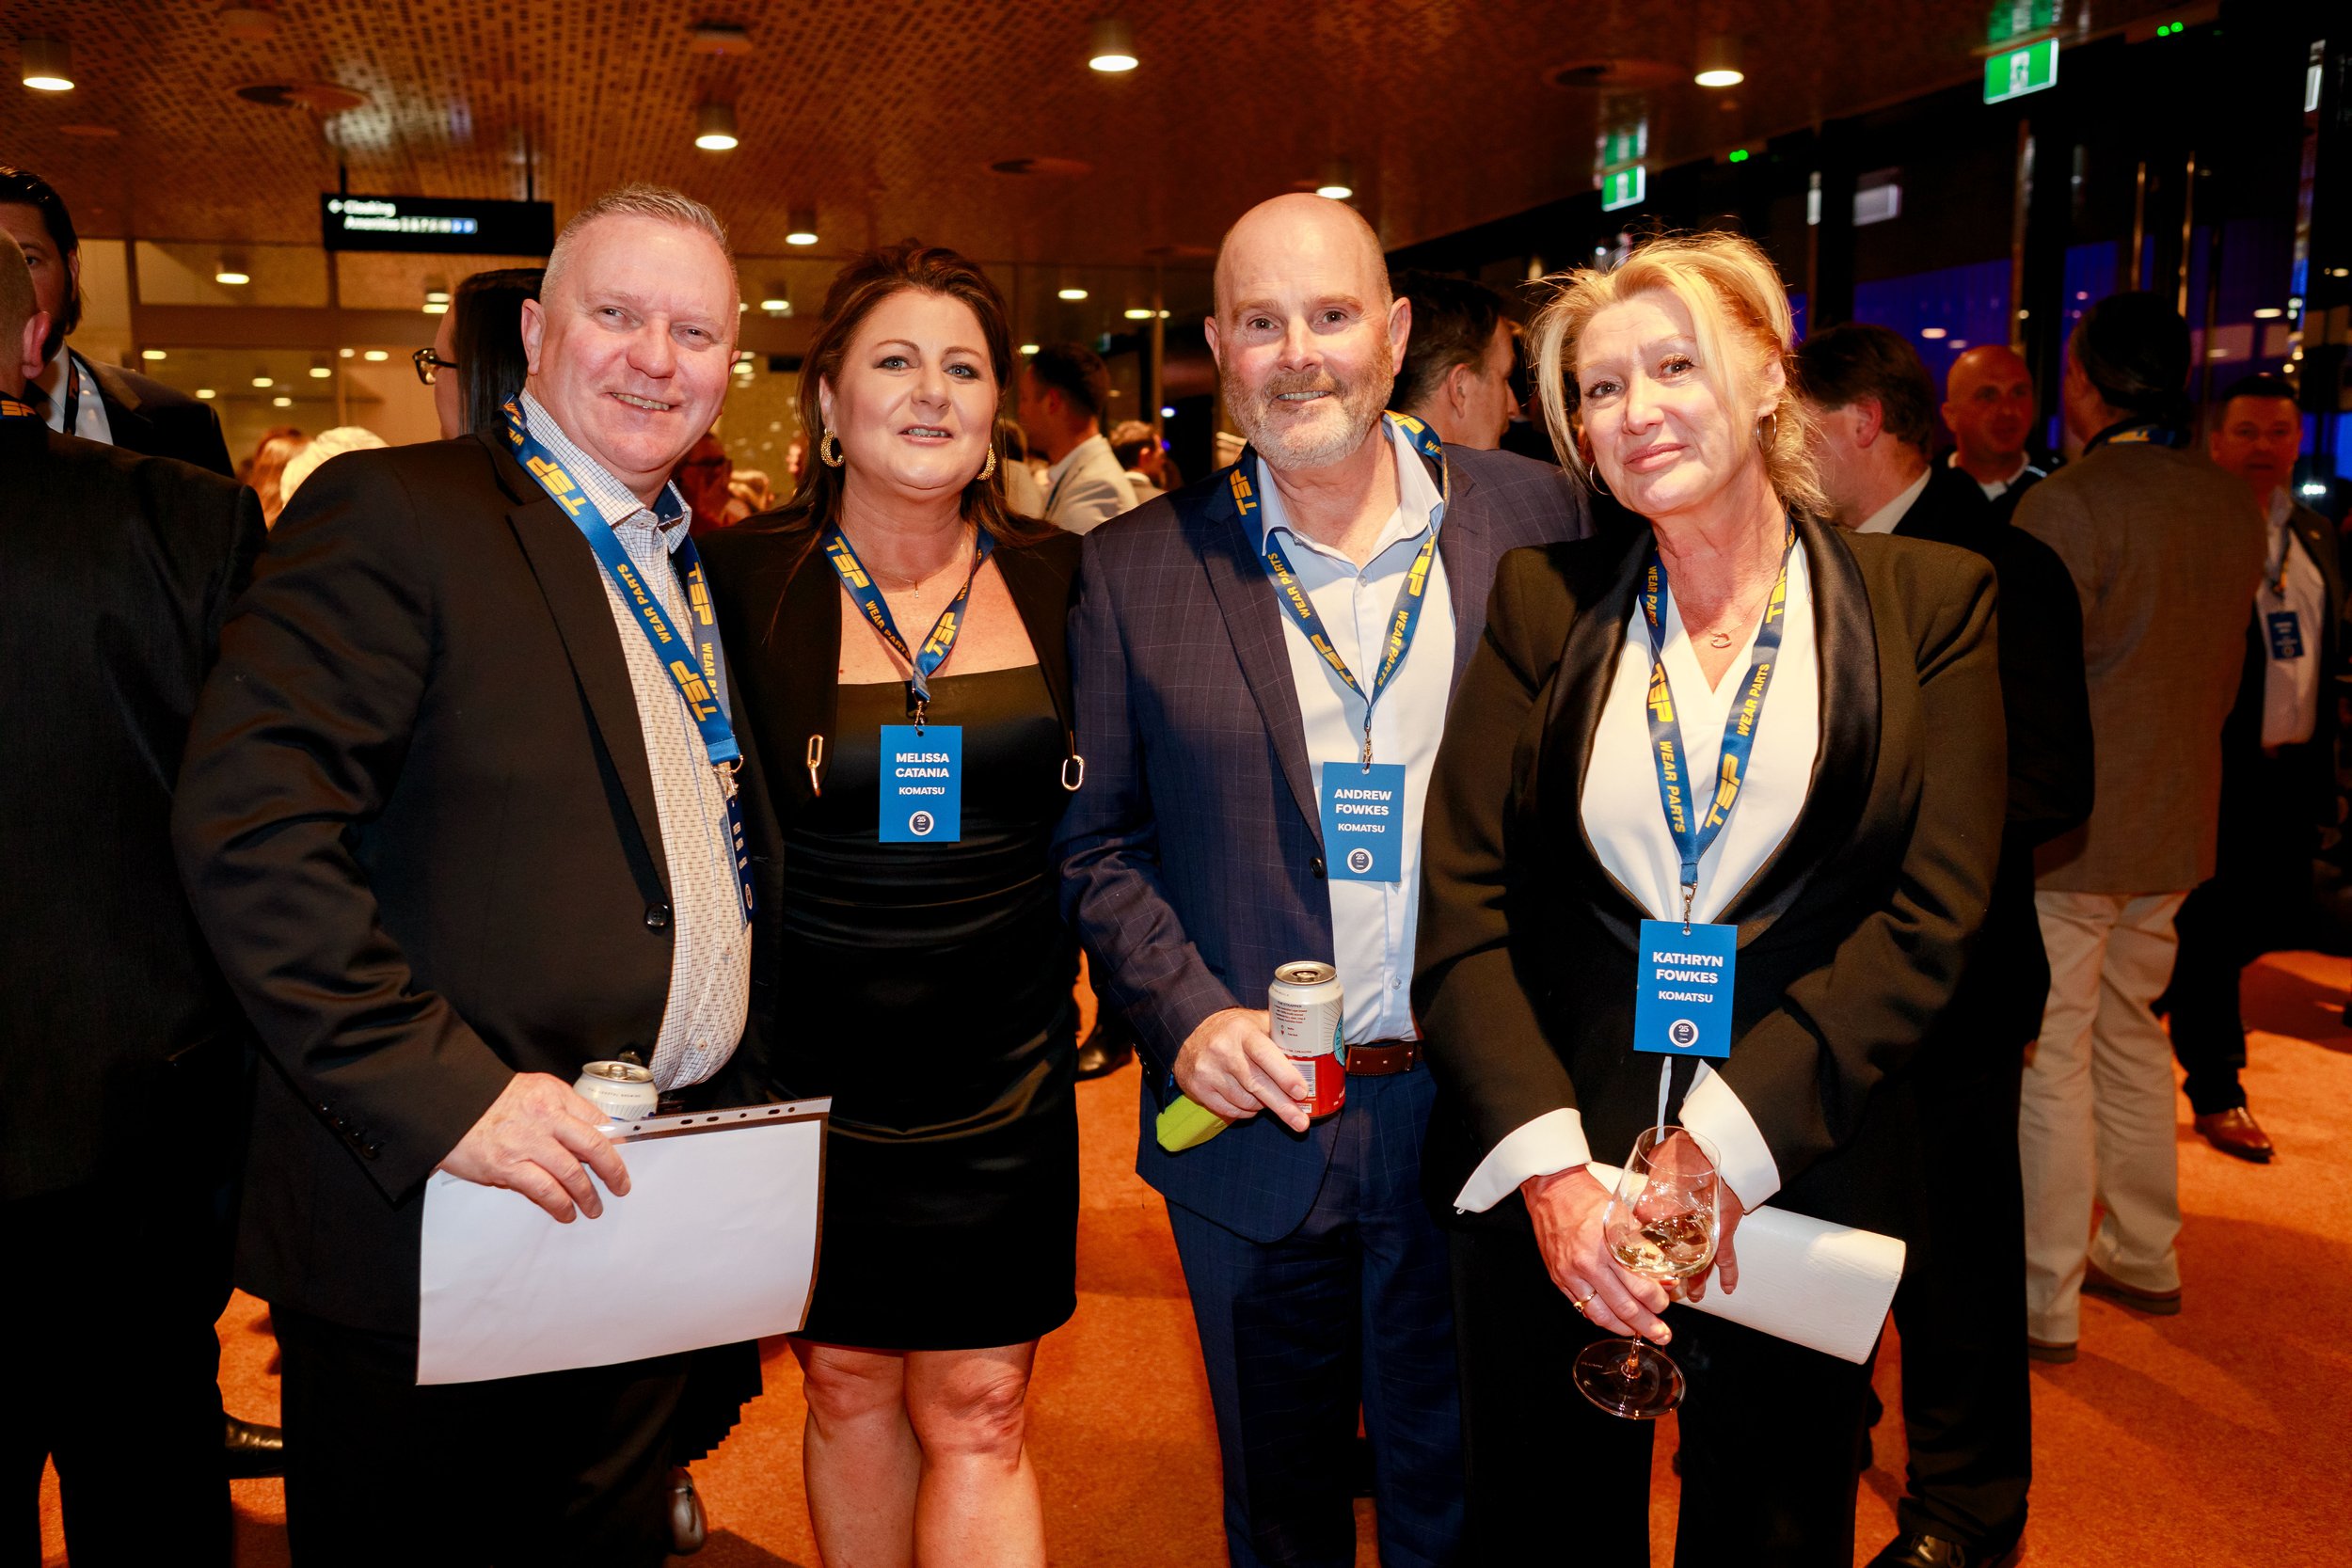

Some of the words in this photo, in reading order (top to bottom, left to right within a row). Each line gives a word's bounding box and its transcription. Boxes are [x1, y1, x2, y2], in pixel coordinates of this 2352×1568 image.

[526, 455, 587, 516] TSP
[1230, 468, 1257, 515] TSP
[826, 536, 871, 589] TSP
[1267, 552, 1294, 586] PARTS
[1408, 534, 1437, 596] TSP
[1647, 565, 1659, 593] WEAR
[616, 563, 650, 607] PARTS
[688, 562, 713, 626] TSP
[1288, 585, 1311, 619] WEAR
[644, 605, 673, 644] WEAR
[865, 600, 885, 630] WEAR
[925, 611, 957, 657] TSP
[1391, 610, 1409, 647] WEAR
[702, 642, 715, 676] WEAR
[1311, 633, 1355, 689] TSP
[1377, 645, 1400, 688] PARTS
[669, 660, 718, 721] TSP
[1648, 663, 1675, 722] TSP
[1737, 698, 1760, 736] WEAR
[1752, 663, 1770, 699] PARTS
[895, 768, 949, 778] CATANIA
[896, 752, 950, 763] MELISSA
[1659, 740, 1674, 782] WEAR
[898, 786, 946, 795] KOMATSU
[1334, 788, 1392, 800] ANDREW
[1335, 803, 1390, 816] FOWKES
[1665, 784, 1686, 833] PARTS
[1705, 752, 1742, 829] TSP
[1338, 823, 1385, 833] KOMATSU
[1652, 951, 1724, 967] KATHRYN
[1656, 968, 1719, 984] FOWKES
[1658, 990, 1713, 1004] KOMATSU
[1677, 1024, 1690, 1033] 25
